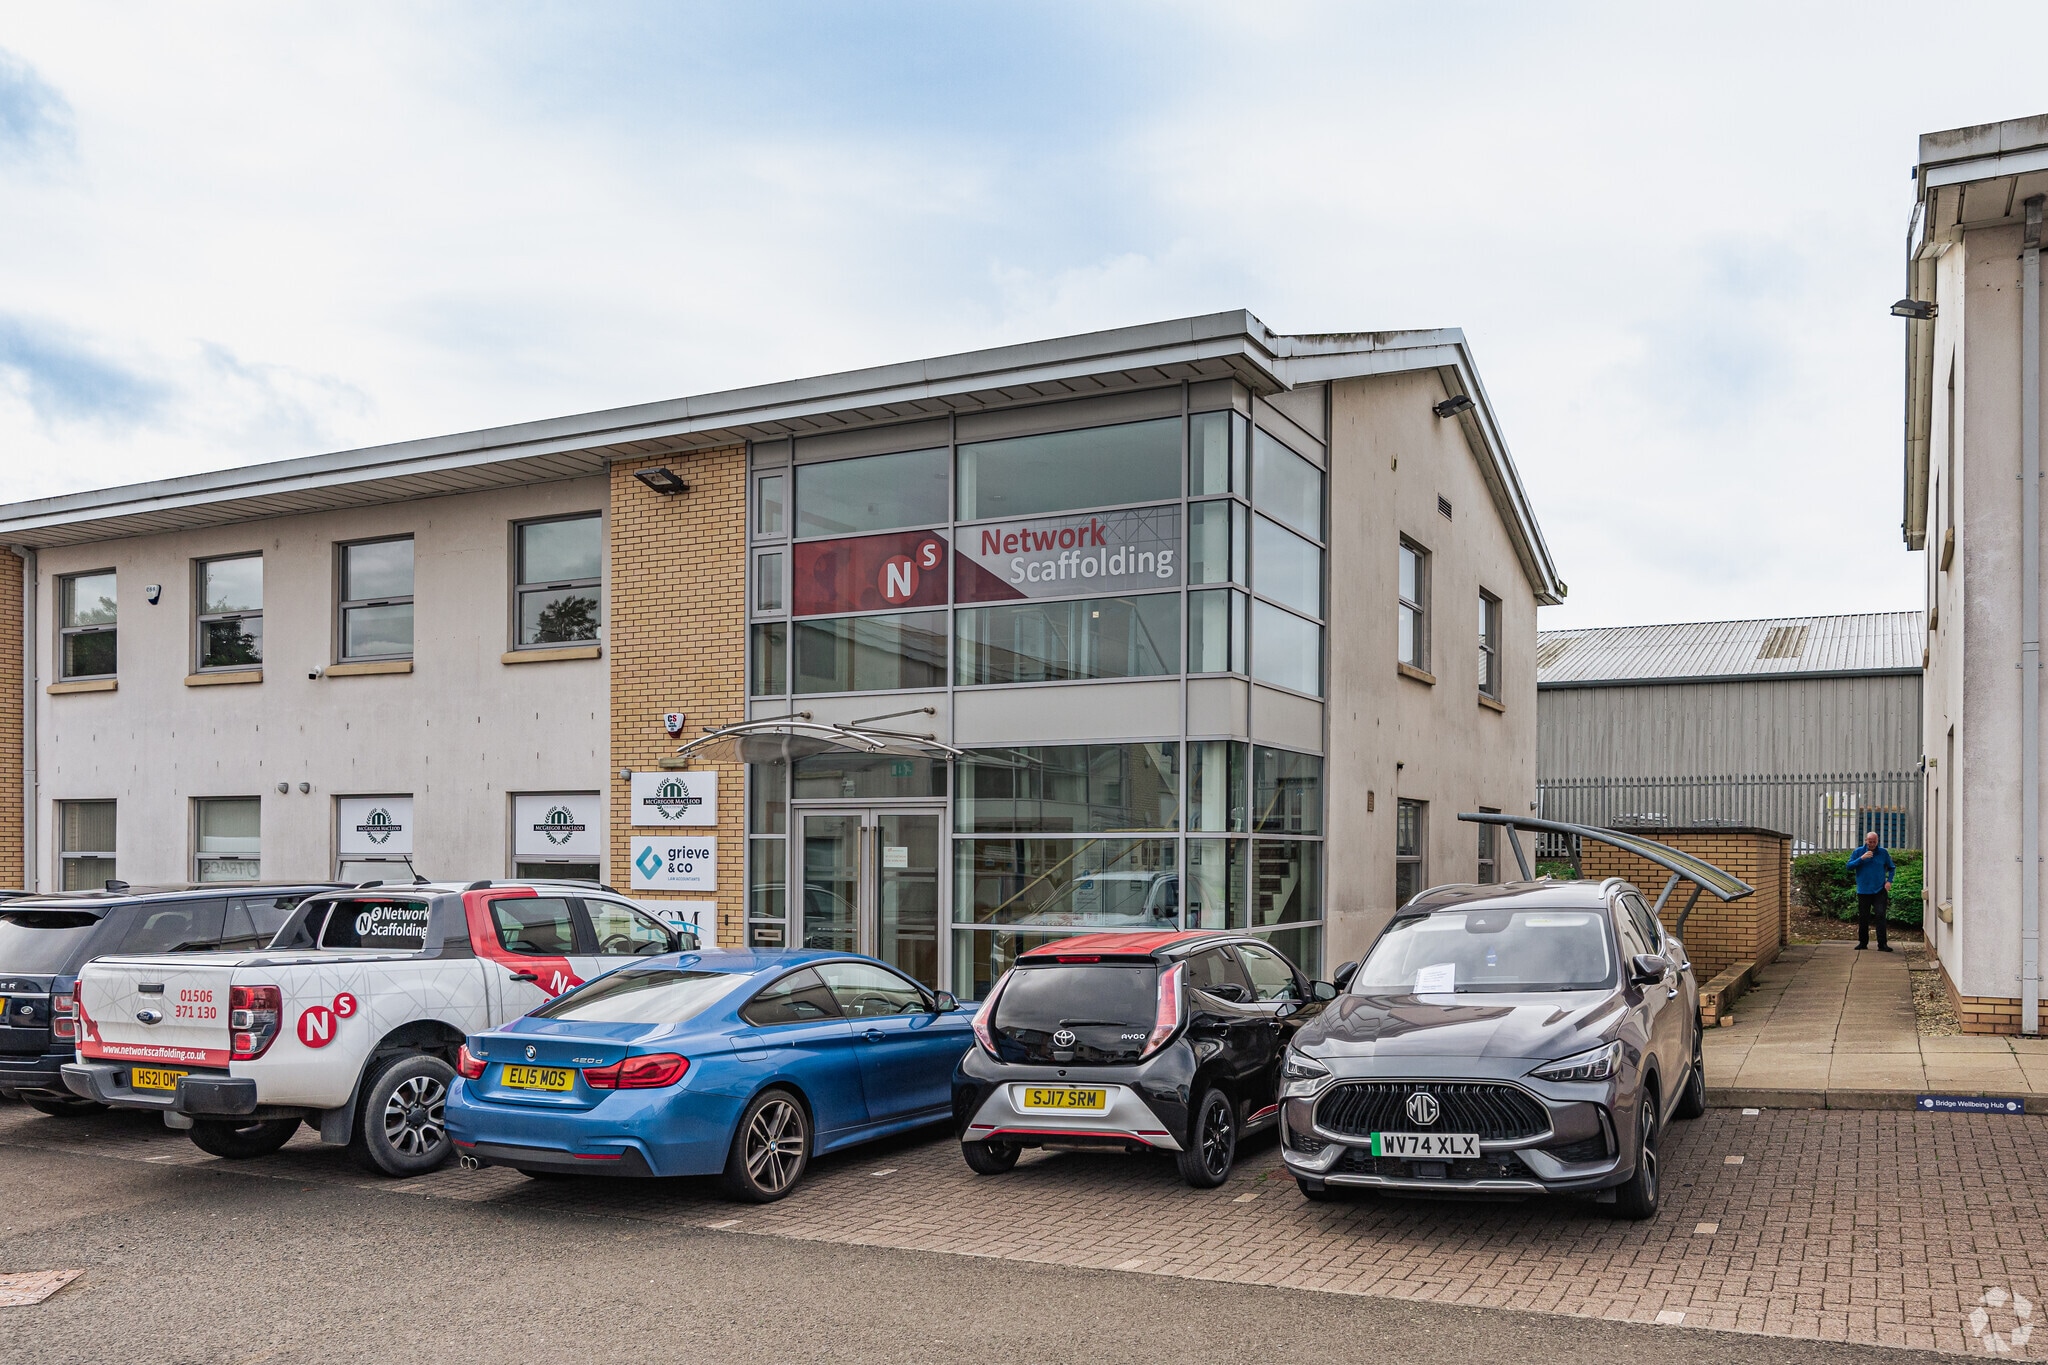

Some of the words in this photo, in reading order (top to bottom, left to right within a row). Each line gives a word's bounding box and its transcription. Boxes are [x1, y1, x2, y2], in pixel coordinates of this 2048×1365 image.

[981, 517, 1106, 556] Network
[1010, 545, 1174, 584] Scaffolding
[887, 561, 911, 598] N
[667, 845, 710, 861] grieve
[667, 862, 675, 873] &
[382, 906, 430, 921] Network
[371, 922, 428, 940] Scaffolding
[180, 989, 213, 1003] 01506
[175, 1005, 194, 1018] 371
[197, 1006, 217, 1019] 130
[306, 1011, 329, 1041] N
[102, 1045, 206, 1061] www.networkscaffolding.co.uk
[138, 1070, 161, 1086] HS21
[509, 1068, 537, 1084] EL15
[540, 1069, 567, 1087] MOS
[1033, 1090, 1065, 1106] SJ17
[1068, 1091, 1097, 1107] SRM
[1935, 1100, 1957, 1108] Bridge
[1957, 1101, 1989, 1109] Wellbeing
[1408, 1095, 1436, 1122] MG
[1384, 1136, 1432, 1154] WV74
[1437, 1137, 1475, 1155] XLX
